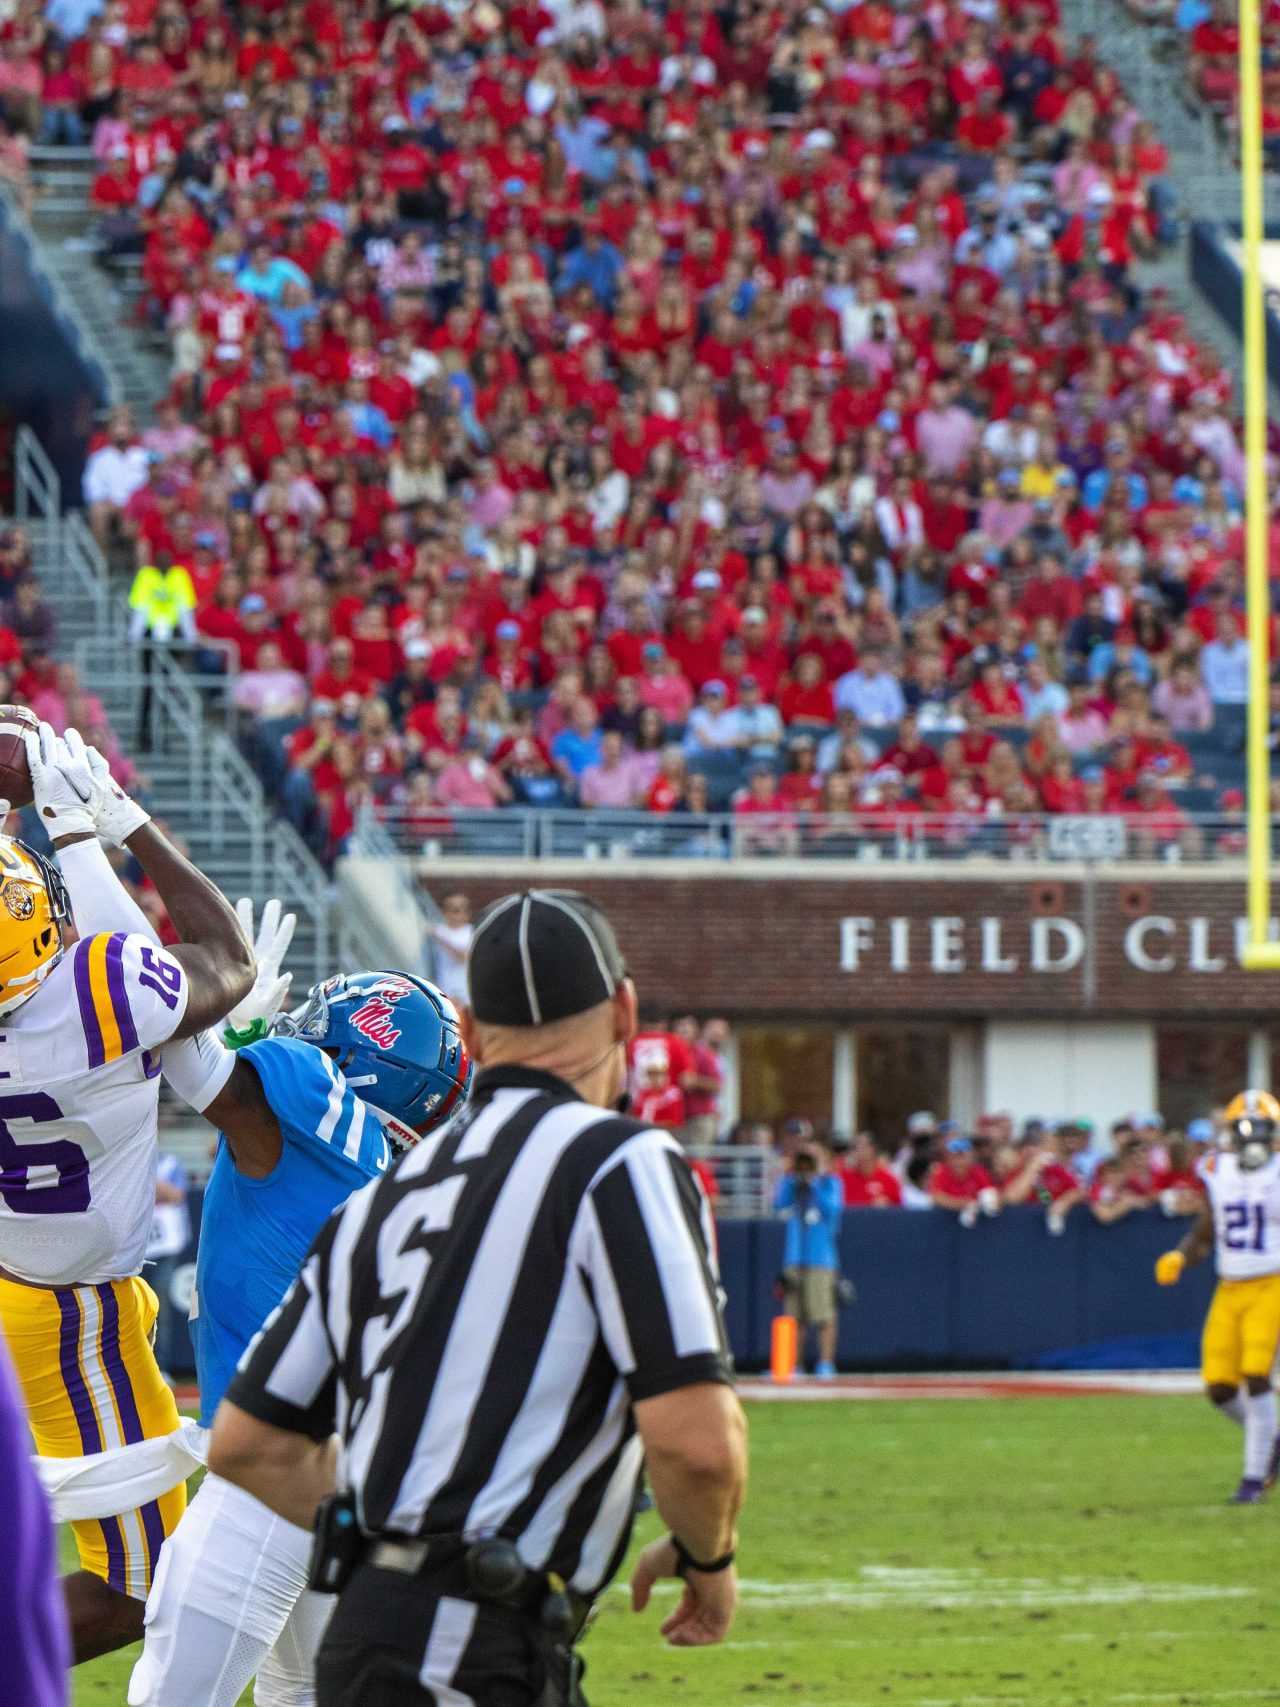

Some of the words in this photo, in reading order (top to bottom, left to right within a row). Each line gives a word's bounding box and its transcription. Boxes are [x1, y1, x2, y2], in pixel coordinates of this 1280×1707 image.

[839, 915, 1087, 974] FIELD
[138, 946, 181, 1011] 16
[349, 997, 402, 1049] Miss
[1223, 1201, 1266, 1252] 21
[361, 1172, 468, 1380] S
